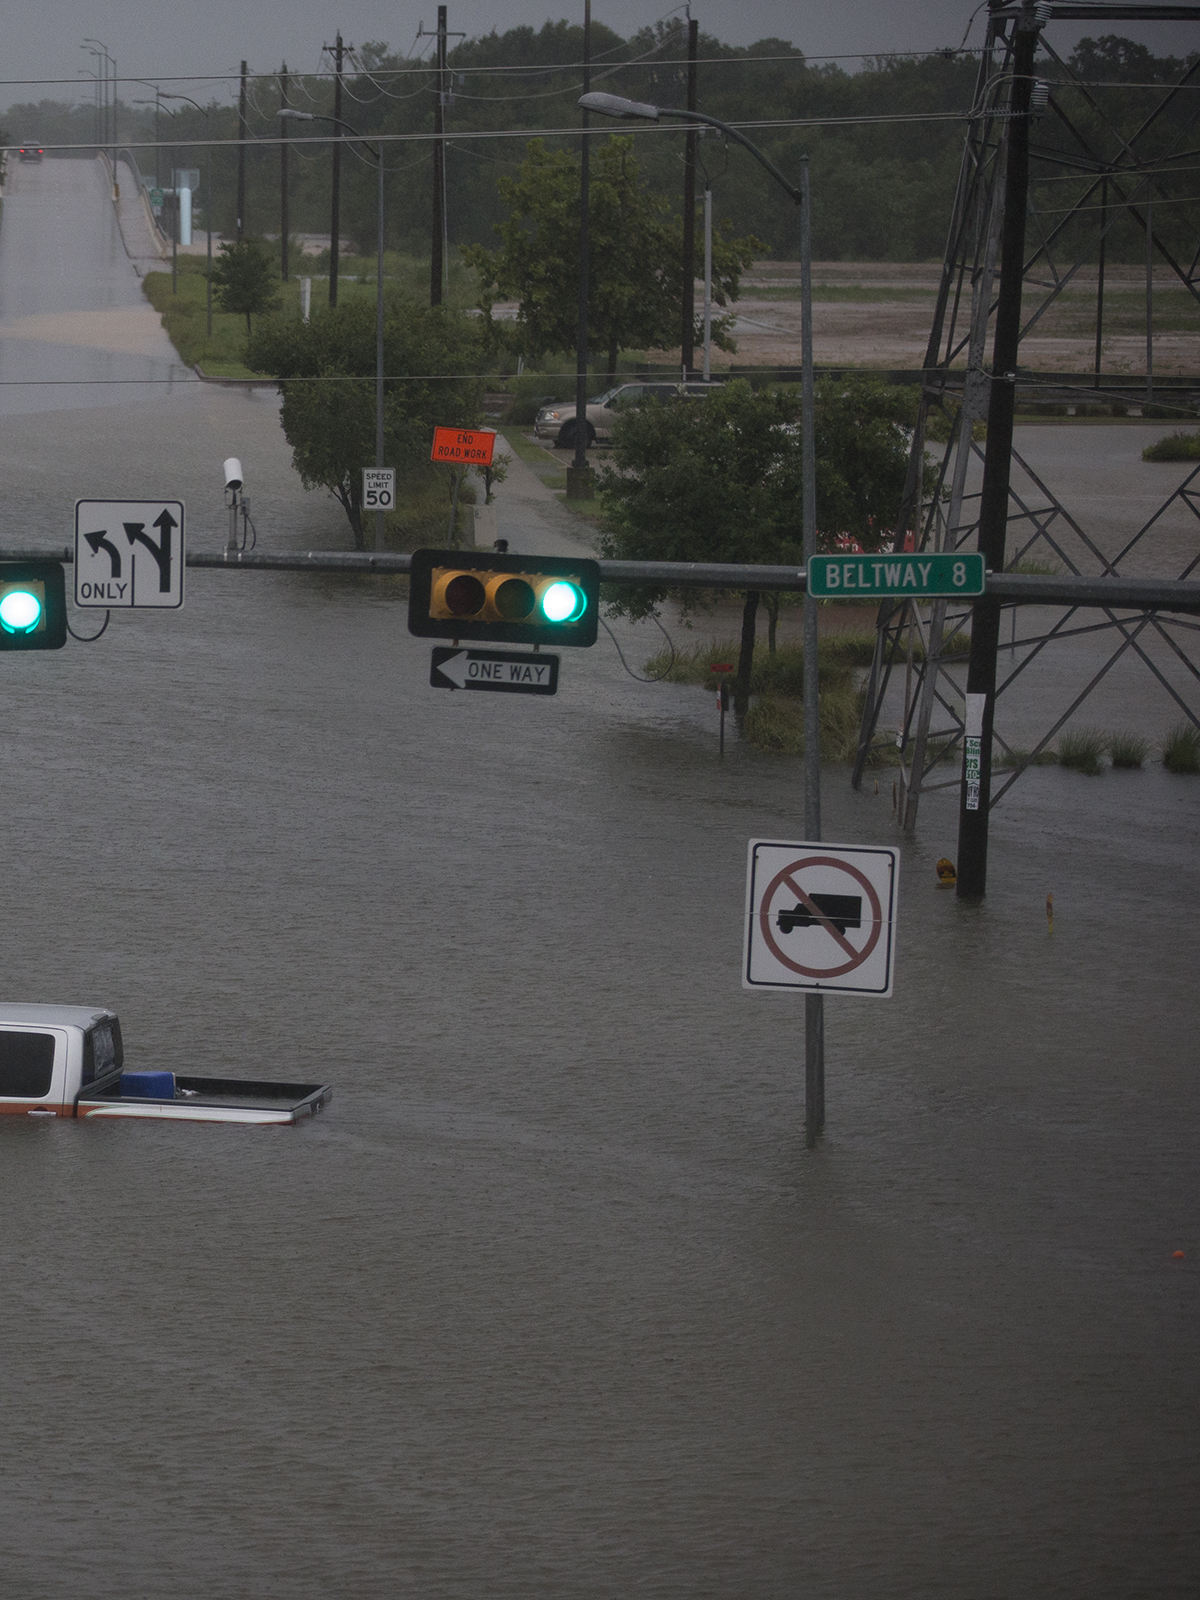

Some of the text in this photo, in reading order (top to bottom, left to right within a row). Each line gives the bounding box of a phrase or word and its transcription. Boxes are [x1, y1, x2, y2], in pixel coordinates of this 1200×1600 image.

[457, 433, 474, 445] END
[438, 446, 487, 460] ROAD WORK
[366, 472, 392, 480] SPEED
[368, 481, 389, 489] LIMIT
[366, 490, 392, 506] 50
[826, 562, 966, 588] BELTWAY 8
[81, 582, 128, 599] ONLY
[468, 662, 545, 682] ONE WAY
